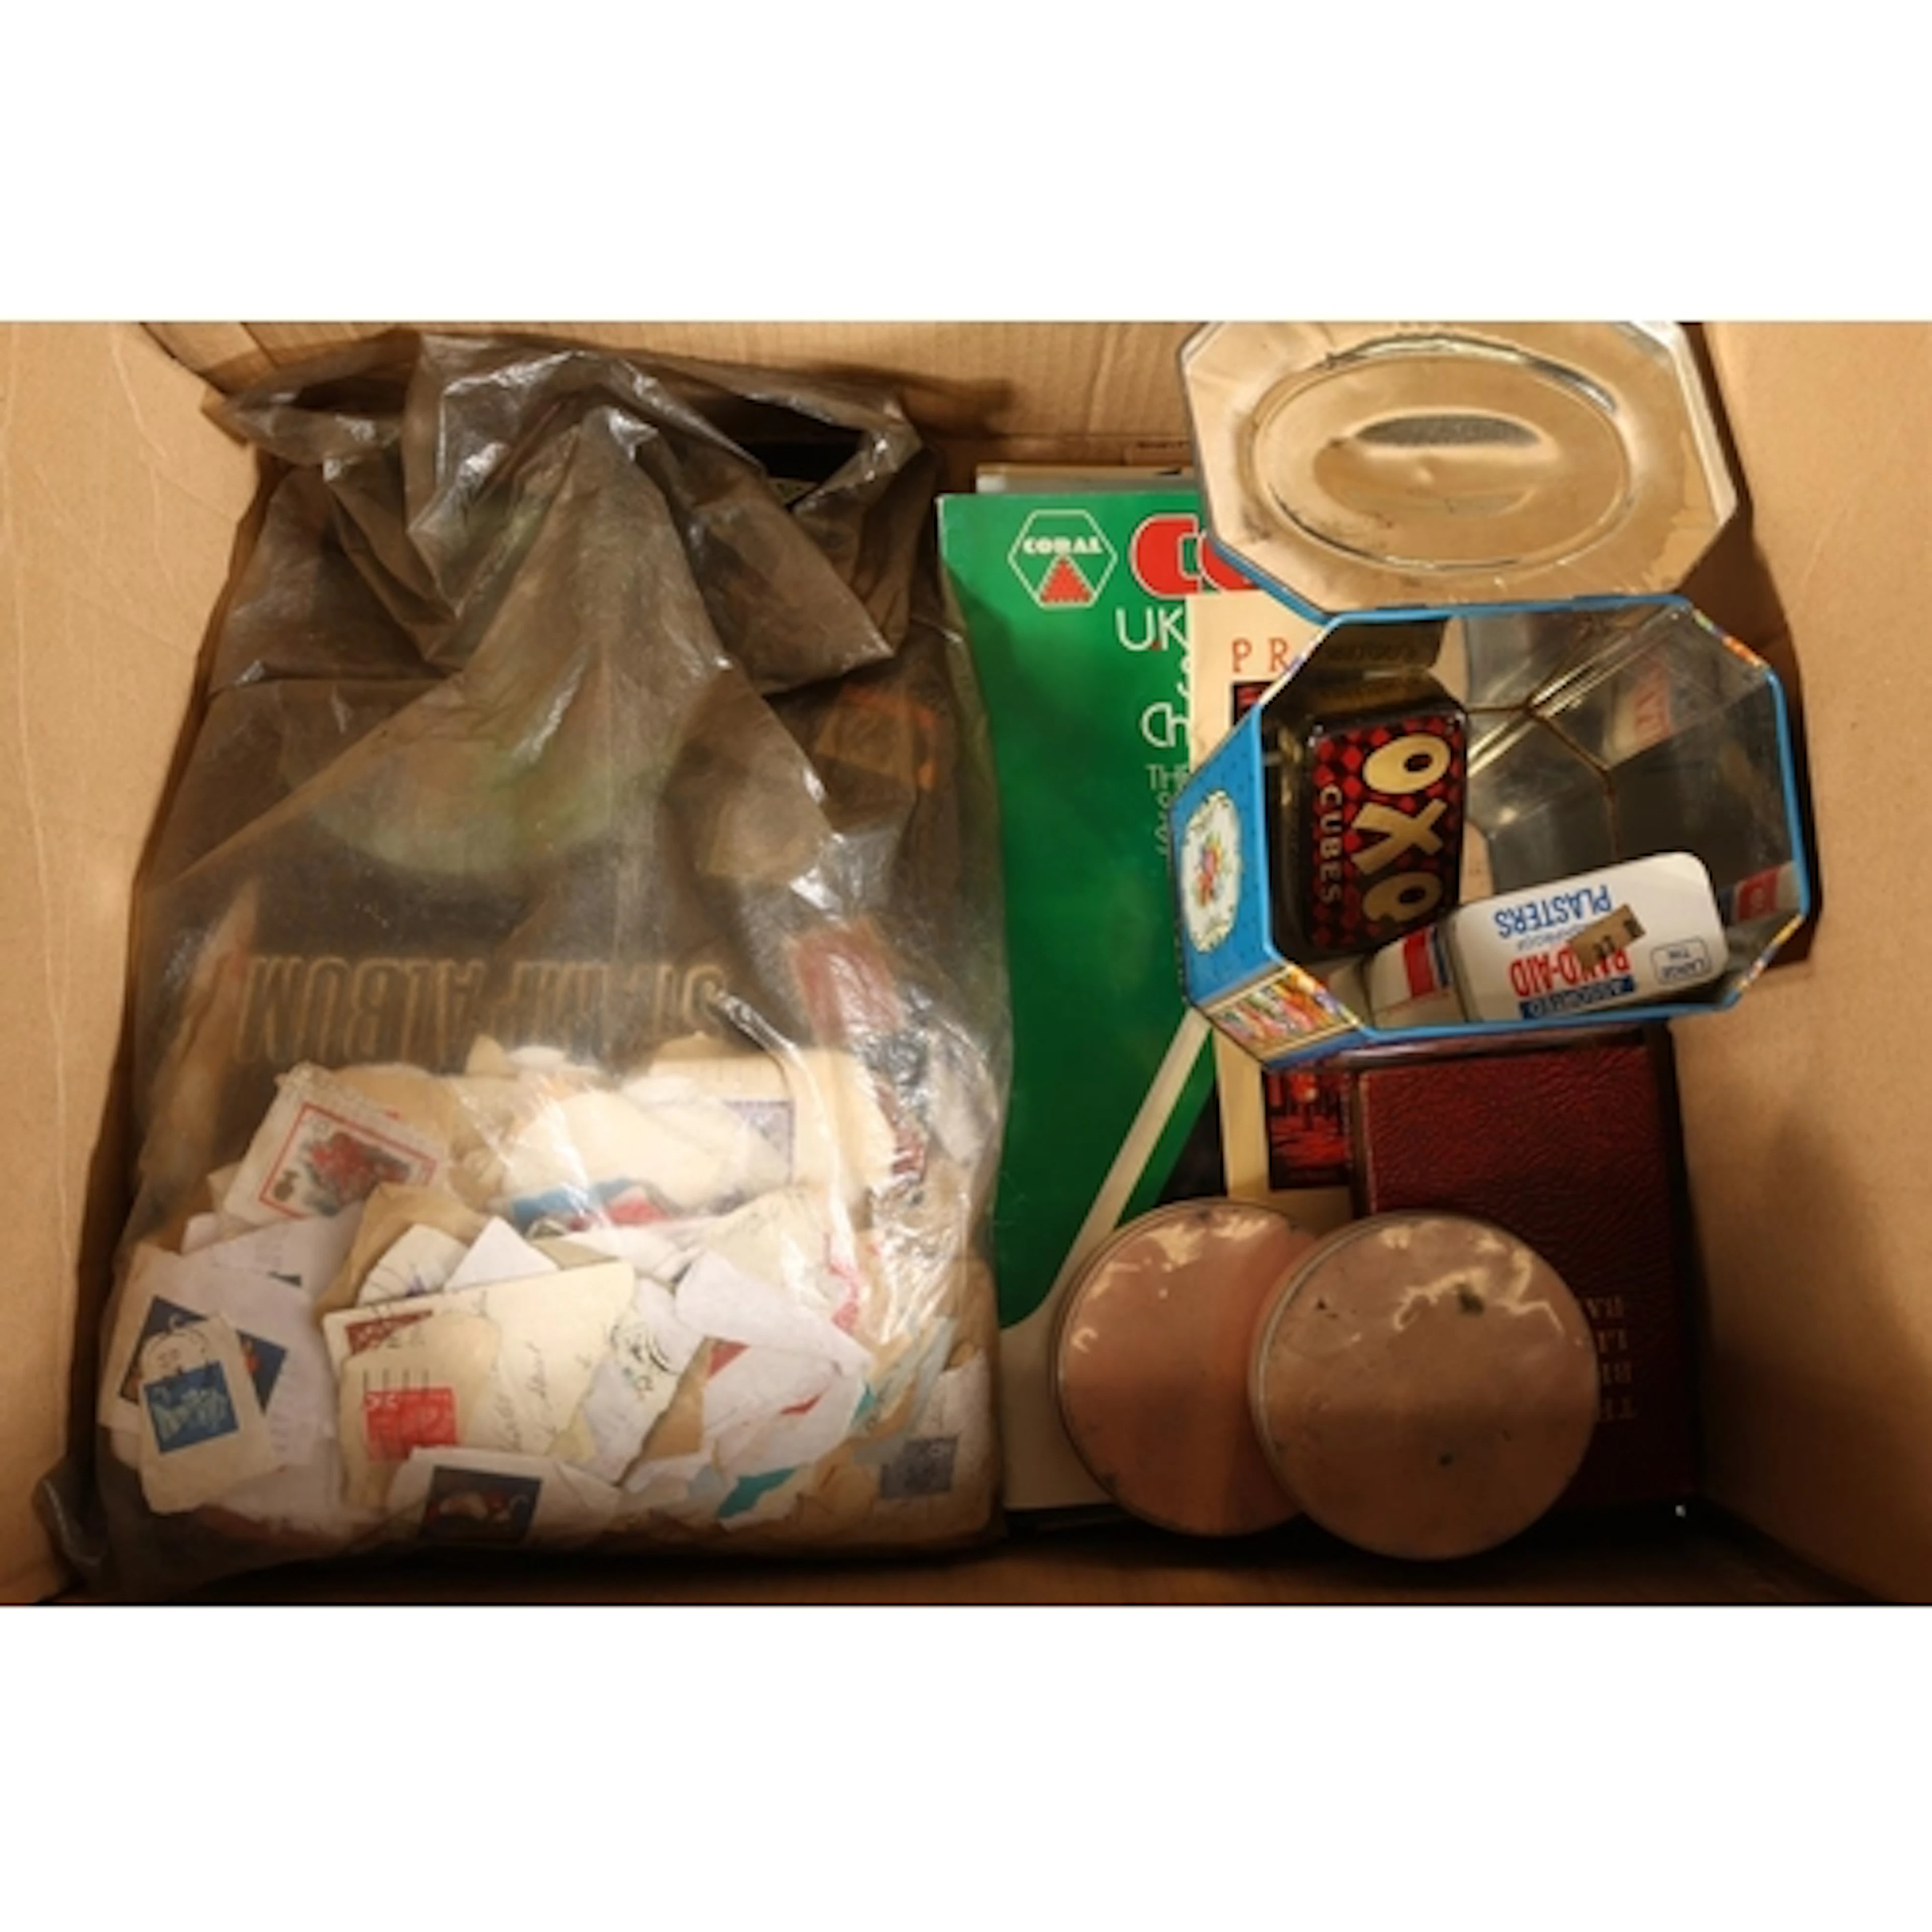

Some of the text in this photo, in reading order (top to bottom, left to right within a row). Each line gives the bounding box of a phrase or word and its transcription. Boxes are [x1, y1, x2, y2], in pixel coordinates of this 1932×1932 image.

[1023, 535, 1103, 555] CORAL
[1319, 784, 1343, 905] CUBES
[1351, 733, 1452, 922] OXO
[1494, 884, 1612, 939] PLASTERS
